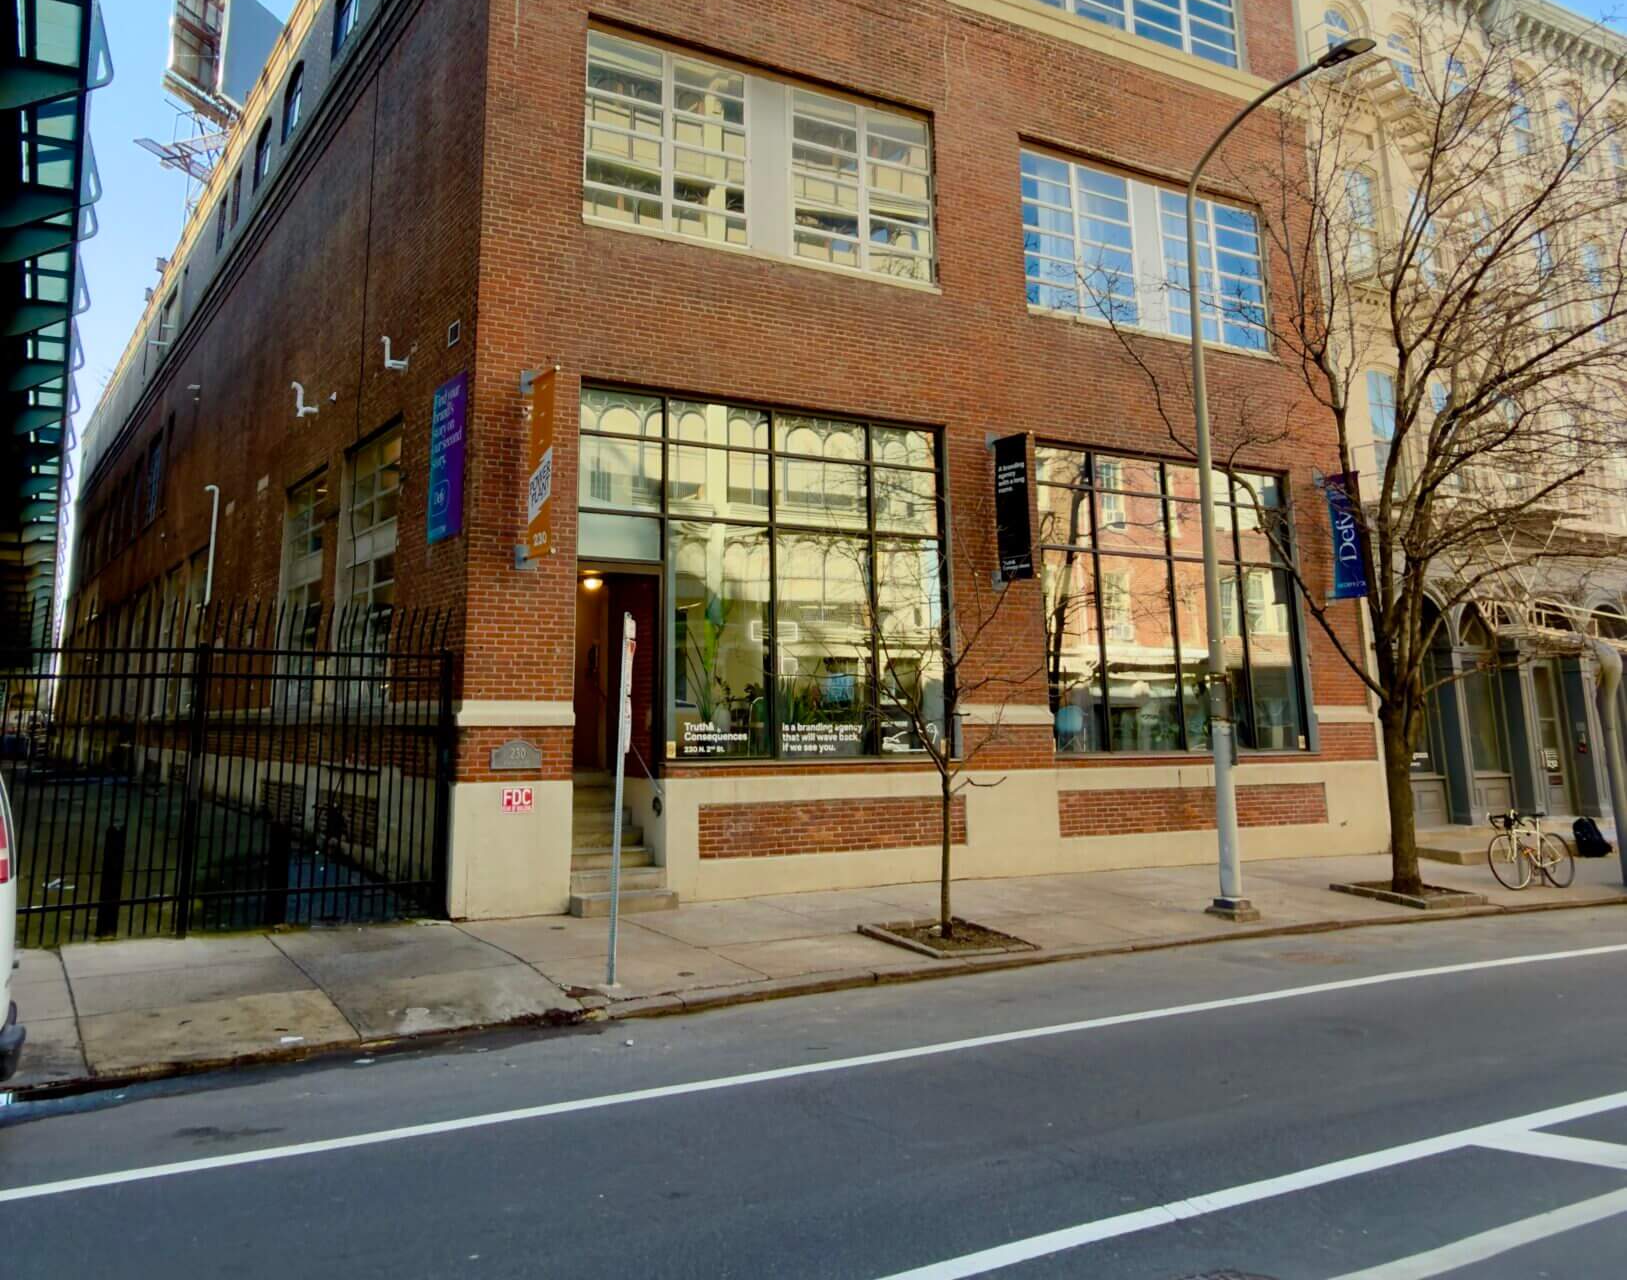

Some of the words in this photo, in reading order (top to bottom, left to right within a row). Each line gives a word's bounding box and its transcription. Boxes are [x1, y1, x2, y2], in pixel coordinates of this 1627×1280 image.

[1336, 511, 1356, 561] Defy
[797, 722, 833, 733] branding
[834, 723, 863, 733] agency
[684, 732, 748, 742] Consequences
[782, 733, 800, 742] that
[801, 733, 816, 742] will
[816, 734, 838, 742] wave
[819, 744, 836, 753] you.
[503, 789, 532, 805] FDC
